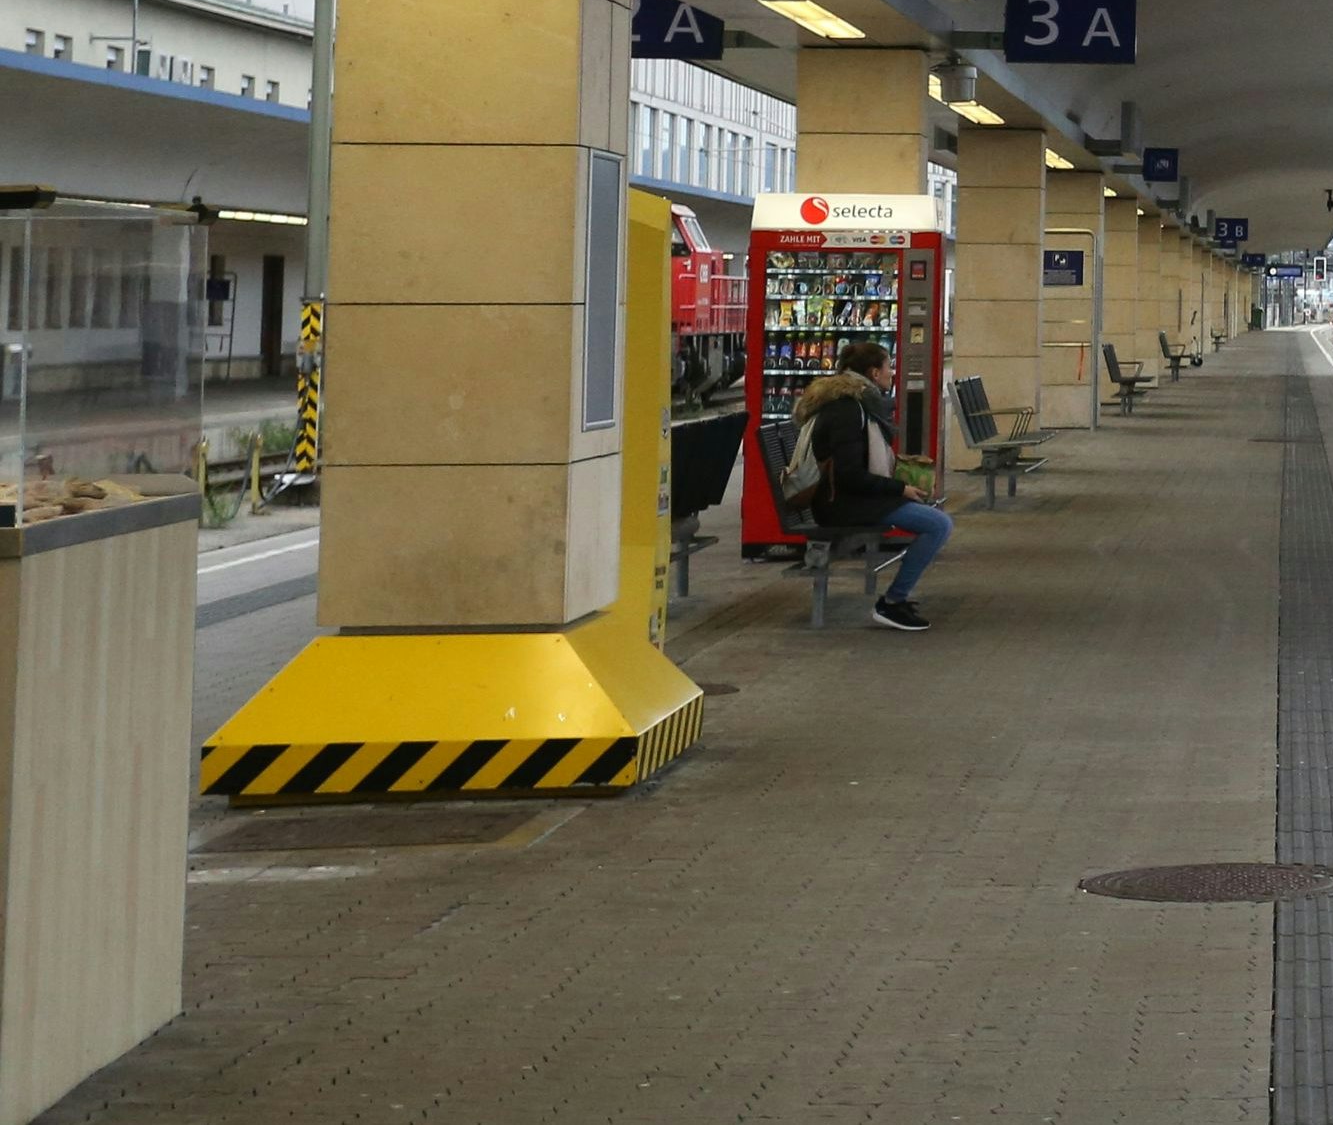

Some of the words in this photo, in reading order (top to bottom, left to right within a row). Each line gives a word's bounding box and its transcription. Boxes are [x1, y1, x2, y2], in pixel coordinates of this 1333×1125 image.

[663, 3, 704, 43] A
[1082, 7, 1121, 47] A
[832, 204, 893, 218] selecta
[1218, 222, 1228, 237] 3
[1235, 226, 1244, 237] B
[807, 235, 820, 243] MIT
